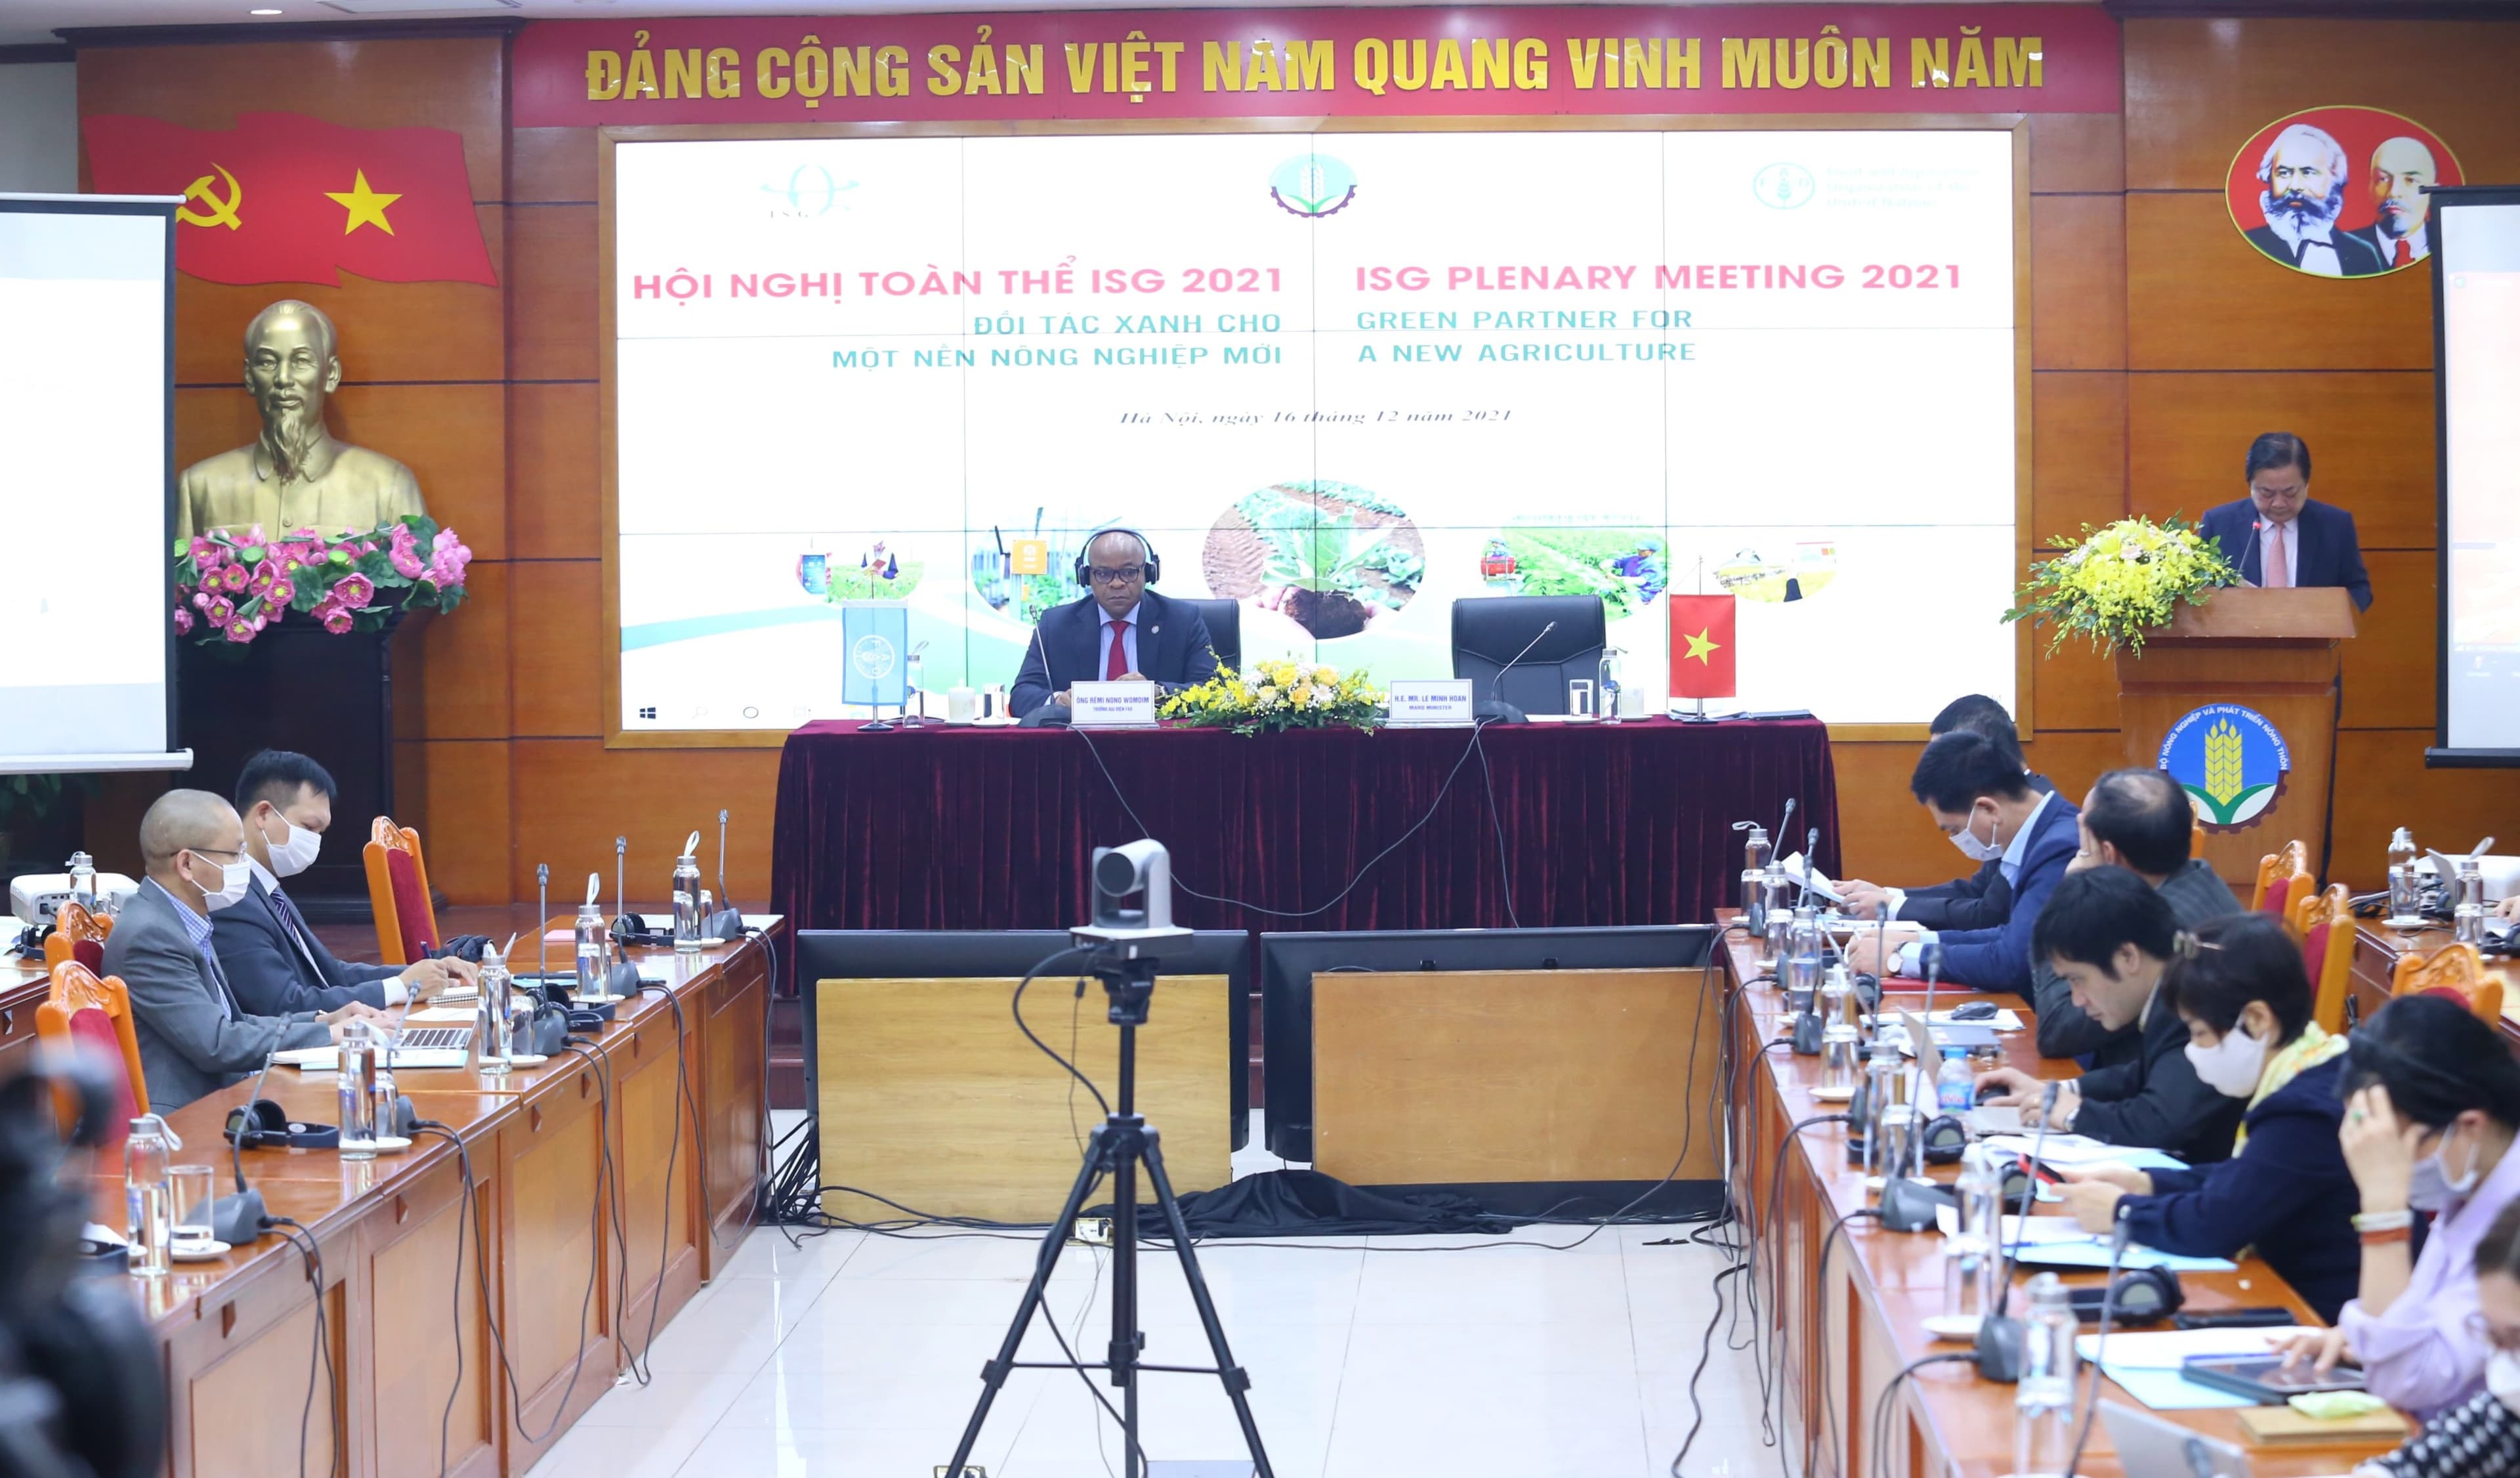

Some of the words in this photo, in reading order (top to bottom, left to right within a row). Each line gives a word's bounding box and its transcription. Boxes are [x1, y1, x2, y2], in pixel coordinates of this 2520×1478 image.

[586, 30, 740, 100] ĐẢNG
[757, 35, 910, 108] CỘNG
[927, 25, 1044, 96] SẢN
[1066, 31, 1184, 103] VIỆT
[1203, 39, 1335, 92] NAM
[1354, 37, 1549, 96] QUANG
[1567, 37, 1701, 90] VINH
[1722, 26, 1891, 89] MUÔN
[1911, 26, 2043, 89] NĂM
[633, 267, 713, 306] HỘI
[730, 272, 843, 305] NGHỊ
[858, 263, 982, 297] TOÀN
[998, 255, 1076, 295] THỂ
[1091, 268, 1166, 294] ISG
[1181, 266, 1280, 293] 2021
[1356, 265, 1431, 292] ISG
[1448, 264, 1637, 291] PLENARY
[1654, 264, 1845, 290] MEETING
[1862, 263, 1960, 289] 2021
[973, 310, 1026, 335] ĐỐI
[1040, 312, 1101, 335] TÁC
[1114, 314, 1203, 335] XANH
[1217, 314, 1282, 333] CHO
[1356, 310, 1458, 331] GREEN
[1472, 310, 1618, 330] PARTNER
[1632, 309, 1692, 329] FOR
[832, 346, 899, 371] MỘT
[913, 343, 976, 368] NỀN
[990, 345, 1079, 368] NÔNG
[1093, 343, 1209, 369] NGHIỆP
[1223, 343, 1282, 365] MỚI
[1358, 345, 1377, 363] A
[1392, 344, 1463, 363] NEW
[1477, 343, 1697, 363] AGRICULTURE
[1120, 412, 1152, 424] Hà
[1272, 412, 1297, 423] 16
[1303, 411, 1366, 425] tháng
[1376, 411, 1399, 422] 12
[1406, 412, 1454, 422] năm
[1461, 410, 1511, 421] 2021
[2202, 706, 2216, 716] VÀ
[2216, 706, 2240, 715] PHÁT
[2241, 709, 2263, 727] TRIỂN
[2176, 711, 2202, 734] NGHIỆP
[2162, 732, 2178, 757] NÔNG
[2263, 724, 2280, 746] NÔNG
[2159, 757, 2170, 771] BỘ
[2277, 747, 2288, 771] THÔN
